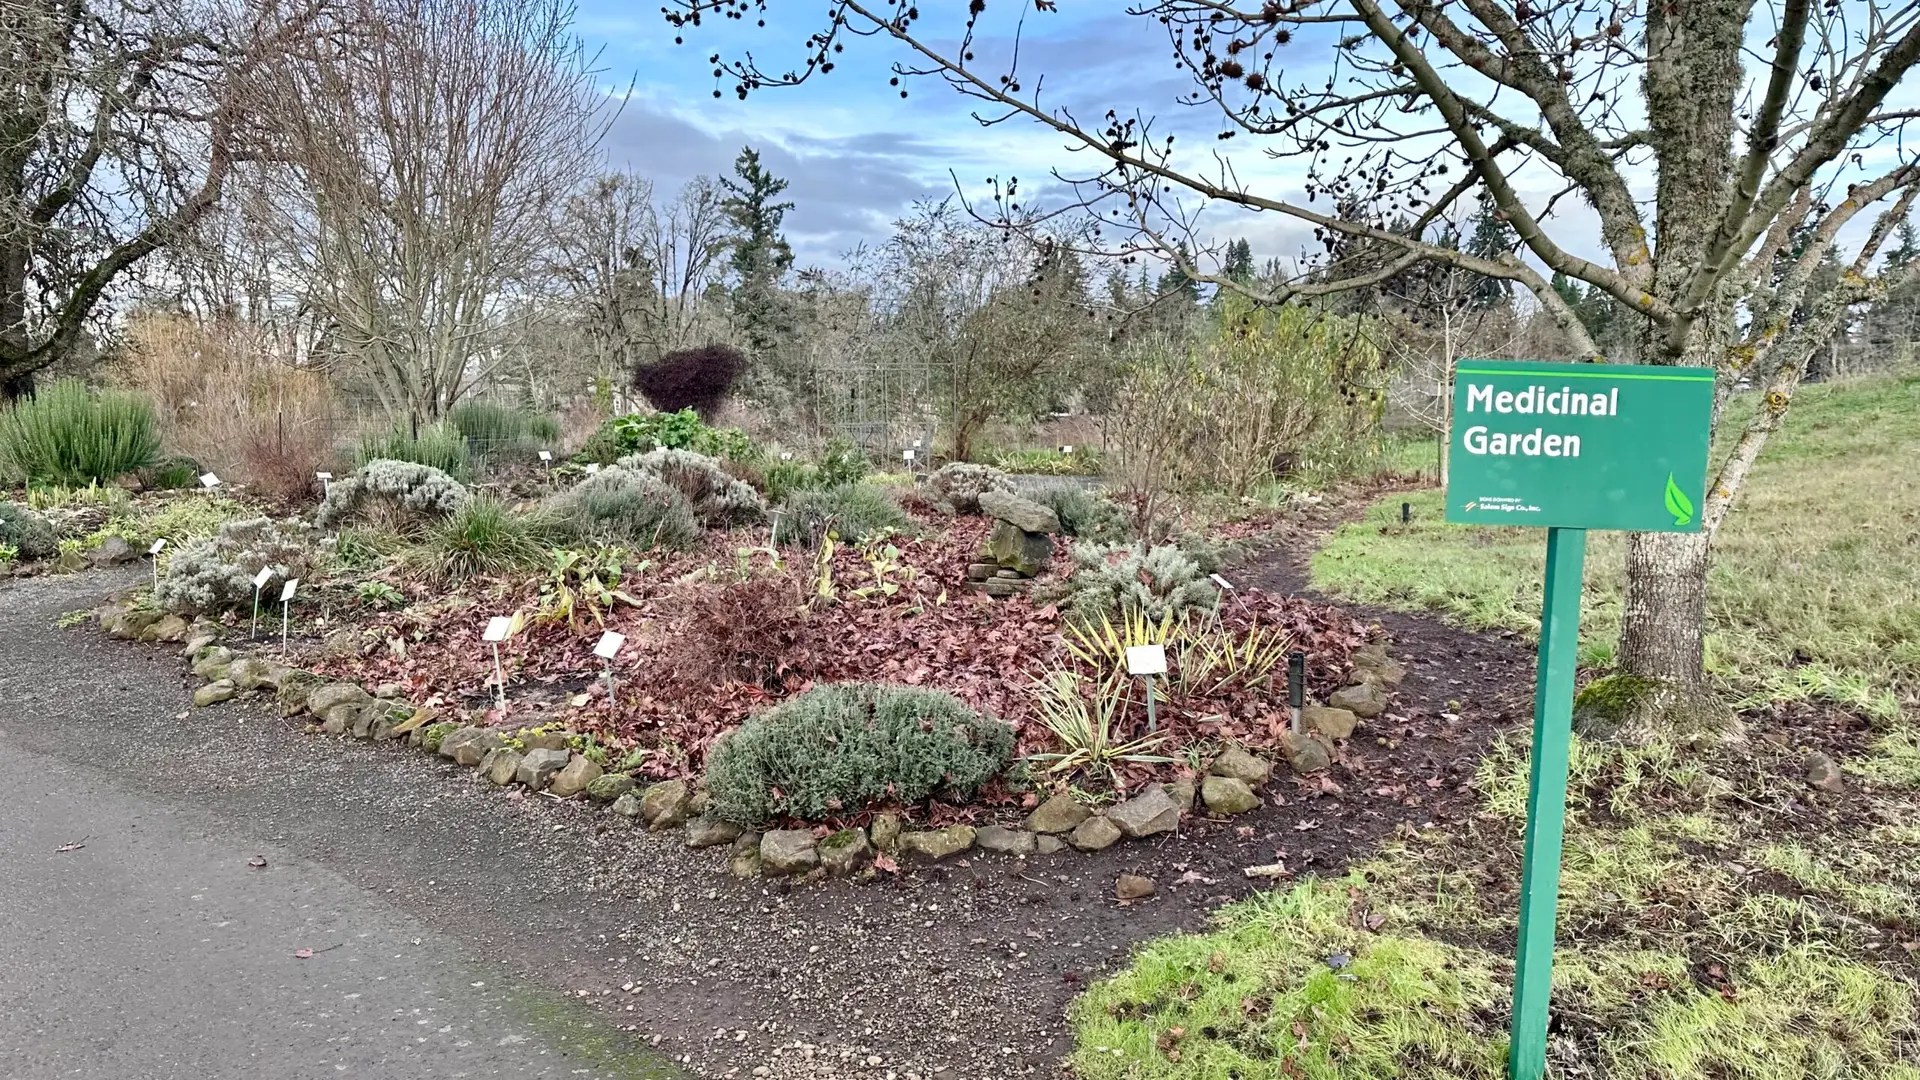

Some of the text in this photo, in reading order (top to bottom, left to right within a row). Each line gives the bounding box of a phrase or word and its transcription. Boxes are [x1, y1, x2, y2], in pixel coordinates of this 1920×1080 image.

[1467, 384, 1618, 416] Medicinal
[1463, 426, 1580, 457] Garden
[1501, 503, 1515, 512] Sign
